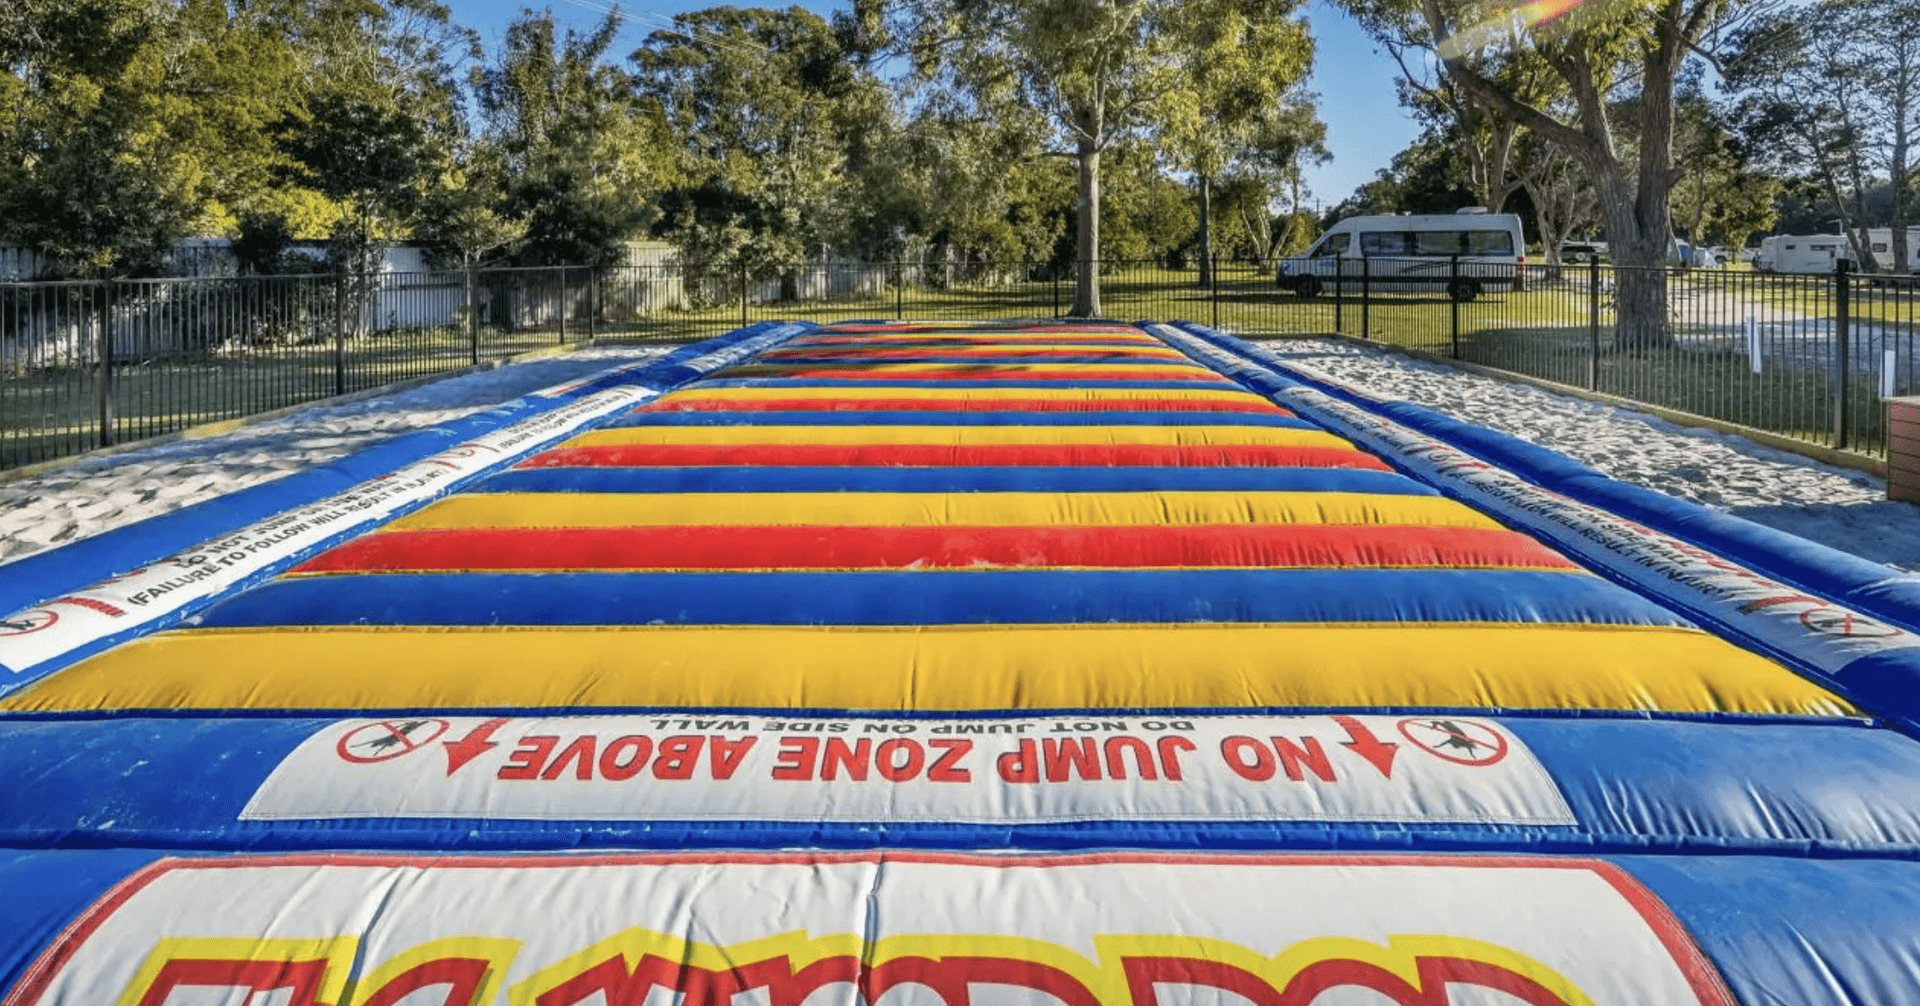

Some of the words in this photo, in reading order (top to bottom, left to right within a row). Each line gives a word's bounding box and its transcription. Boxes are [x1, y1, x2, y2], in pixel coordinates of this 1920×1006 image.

[127, 564, 222, 606] (FAILURE
[216, 551, 246, 566] TO
[244, 521, 311, 553] FOLLOW
[309, 510, 348, 528] WILL
[650, 718, 749, 731] WALL
[762, 721, 850, 733] SIDE
[863, 722, 917, 734] ON
[929, 723, 1035, 735] JUMP
[1050, 722, 1129, 732] NOT
[1141, 720, 1195, 732] DO
[496, 734, 759, 781] ABOVE
[770, 736, 973, 783] ZONE
[996, 735, 1198, 784] JUMP
[1220, 735, 1338, 782] NO
